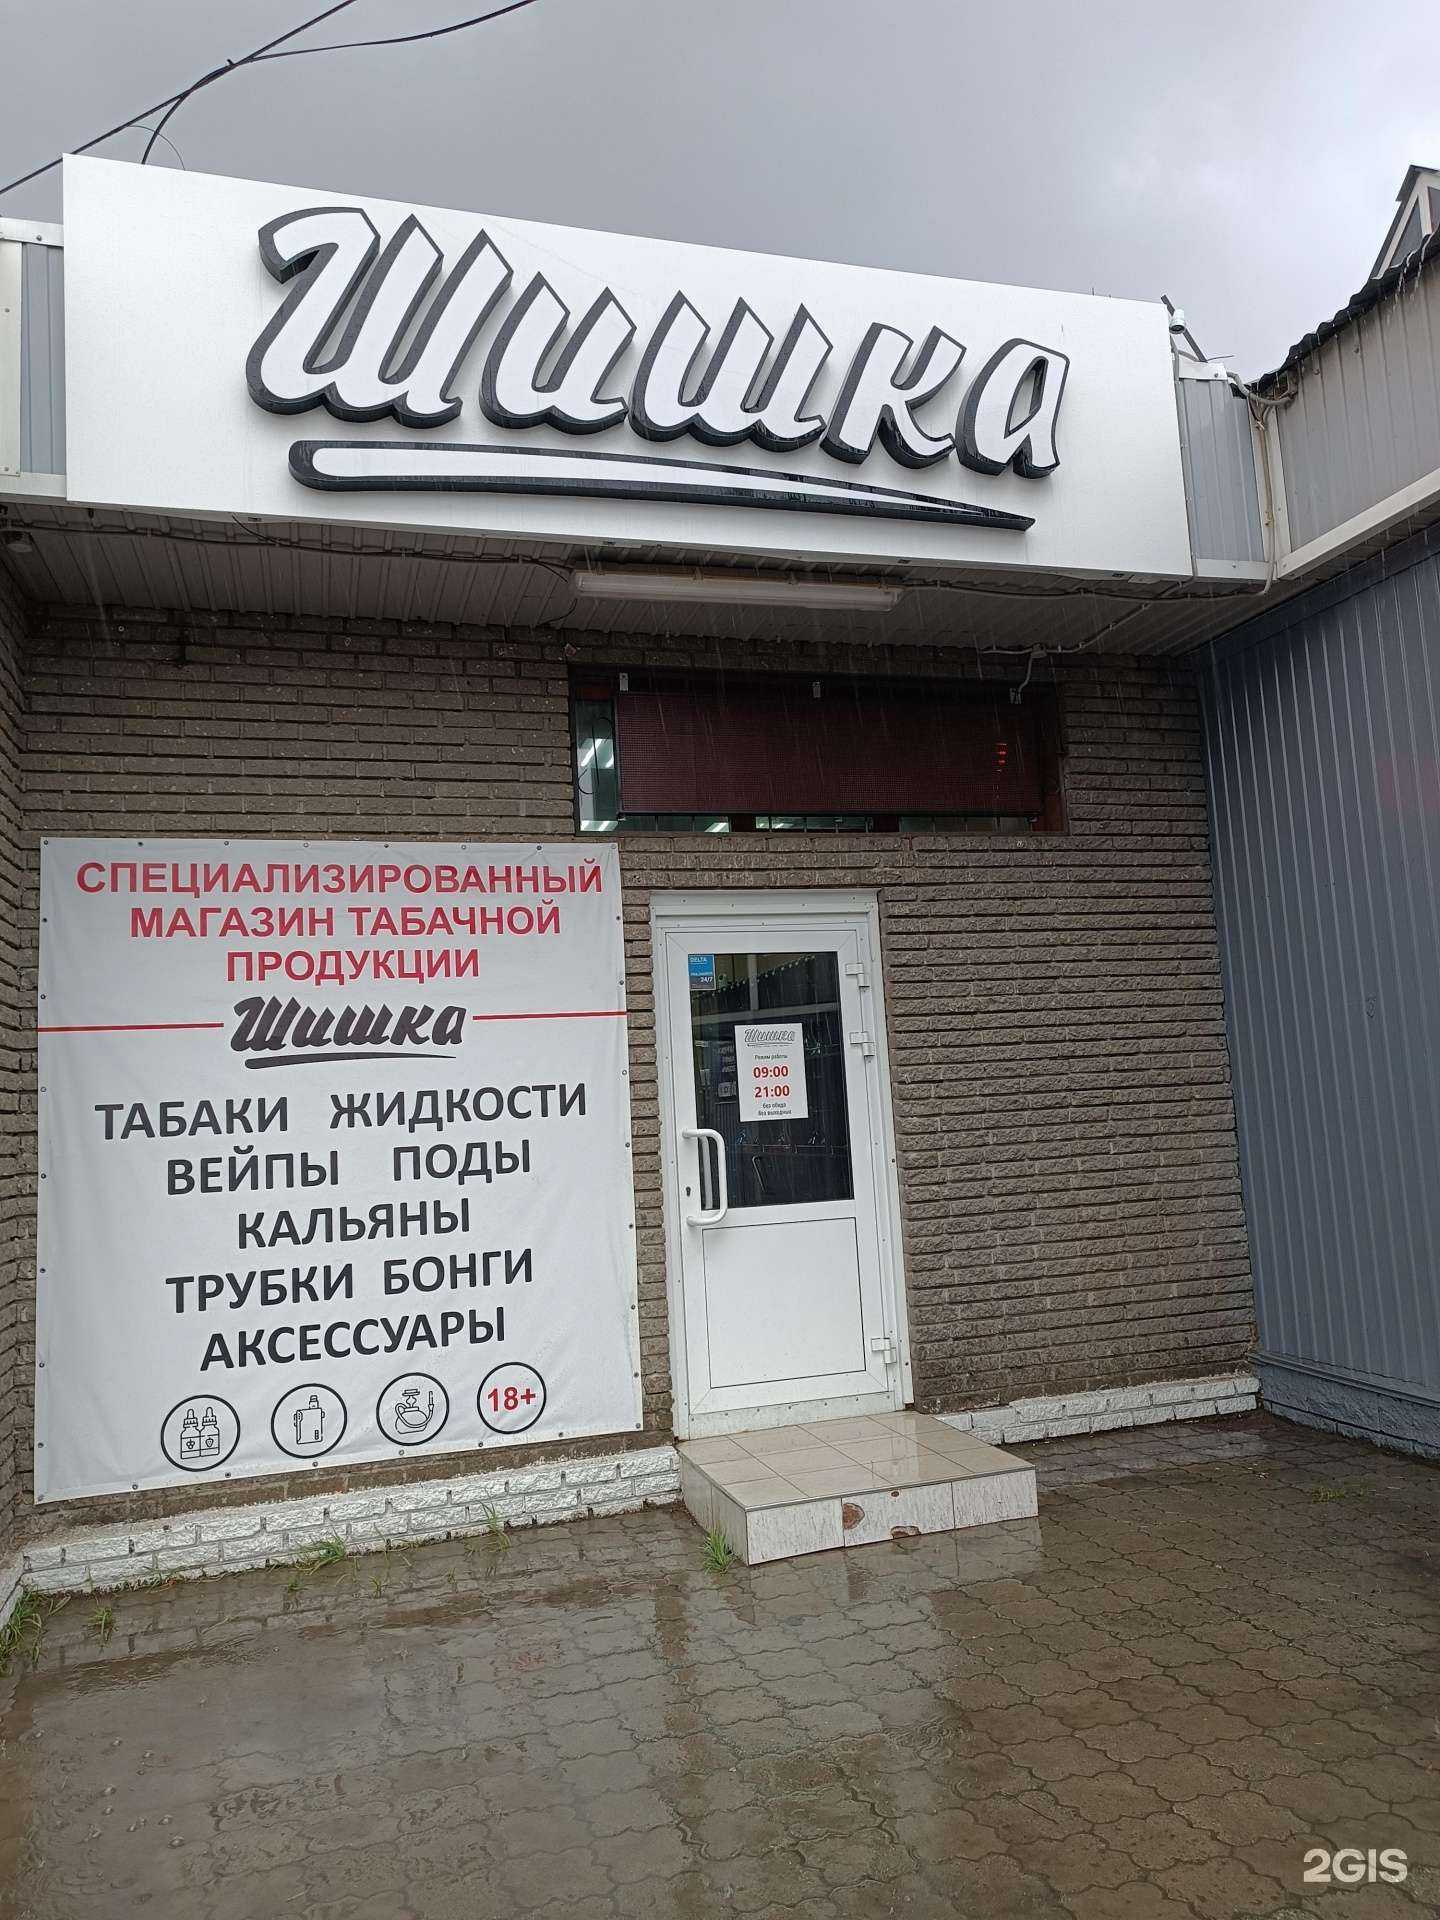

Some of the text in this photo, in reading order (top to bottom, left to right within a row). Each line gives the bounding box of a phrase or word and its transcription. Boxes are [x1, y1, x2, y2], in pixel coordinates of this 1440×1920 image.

[246, 206, 1070, 479] Шишка
[77, 858, 602, 897] СПЕЦИАЛИЗИРОВАННЫЙ
[131, 899, 561, 938] МАГАЗИН ТАБАЧНОЙ
[227, 949, 480, 986] ПРОДУКЦИИ
[231, 996, 466, 1051] Шишка
[753, 1065, 789, 1079] 09:00
[754, 1085, 790, 1098] 21:00
[95, 1083, 586, 1140] ТАБАКИ ЖИДКОСТИ
[168, 1140, 530, 1195] ВЕЙПЫ ПОДЫ
[238, 1198, 470, 1249] КАЛЬЯНЫ
[166, 1249, 533, 1313] ТРУБКИ БОНГИ
[200, 1307, 505, 1371] АКСЕССУАРЫ
[488, 1387, 536, 1412] 18+
